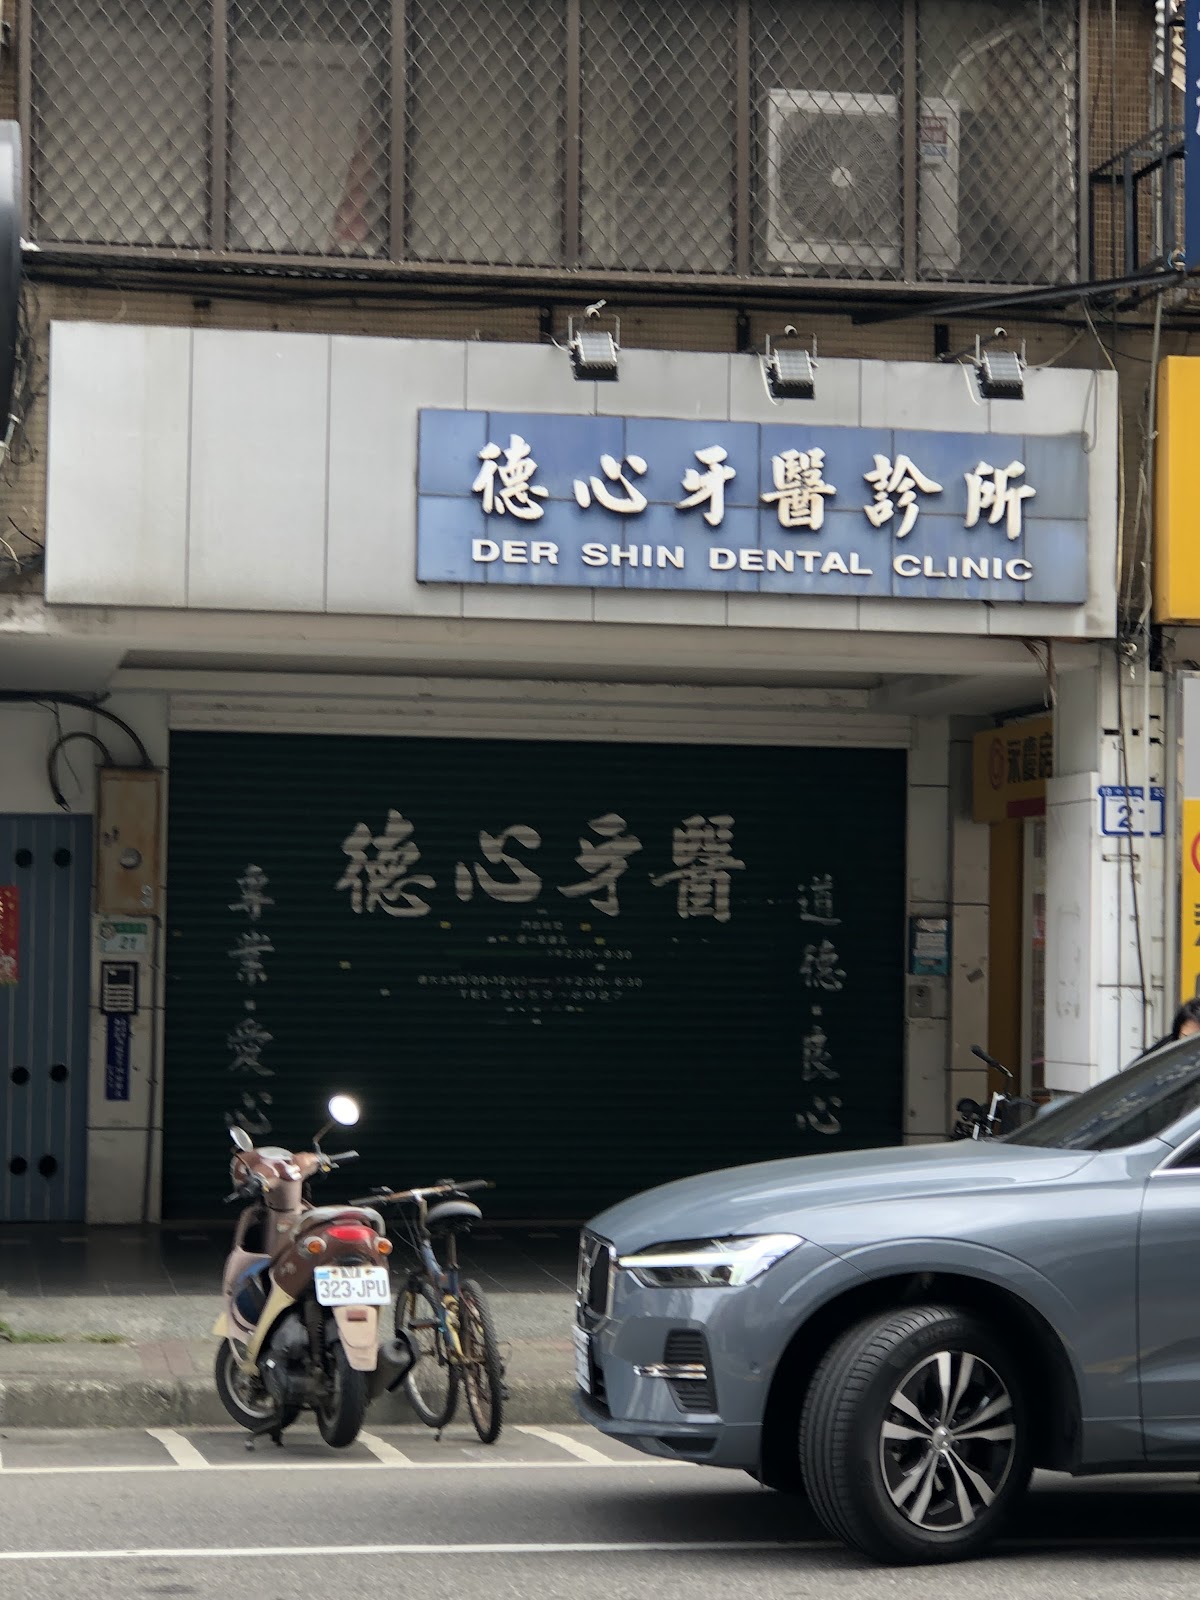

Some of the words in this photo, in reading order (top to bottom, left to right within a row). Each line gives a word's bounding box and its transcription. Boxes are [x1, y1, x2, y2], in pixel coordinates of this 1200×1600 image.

[472, 433, 1036, 540] 德心牙醫診所
[471, 539, 559, 565] DER
[581, 542, 685, 569] SHIN
[708, 547, 873, 575] DENTAL
[893, 553, 1034, 581] CLINIC
[337, 809, 746, 922] 德心牙醫
